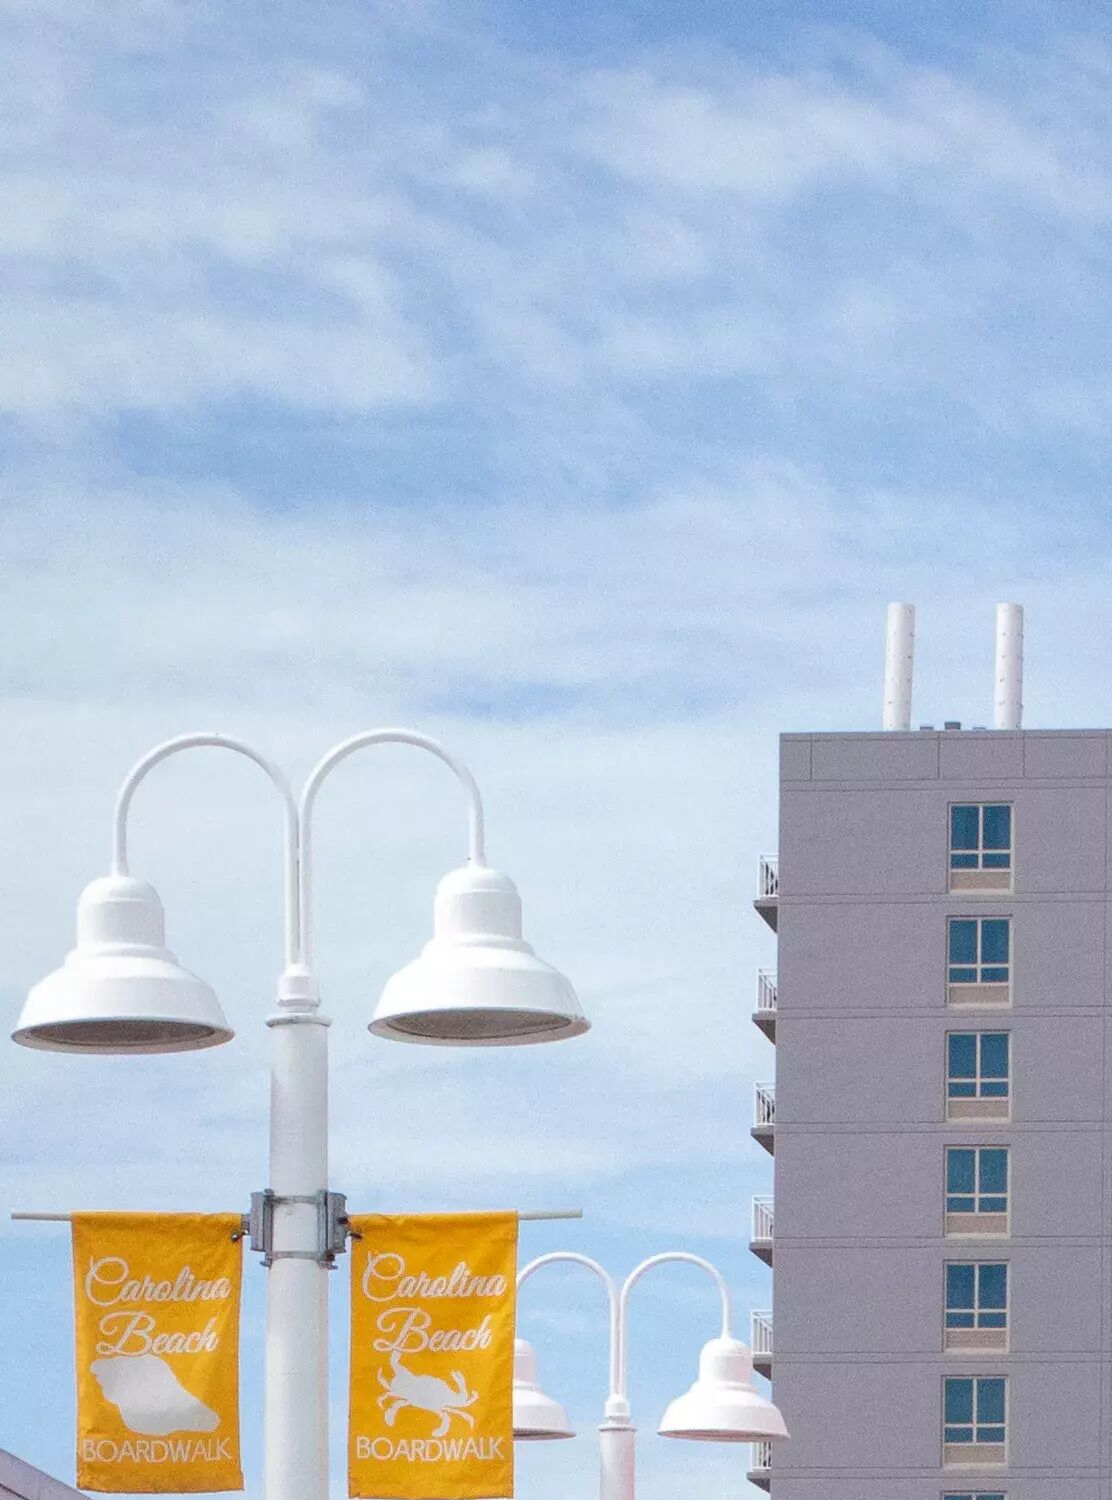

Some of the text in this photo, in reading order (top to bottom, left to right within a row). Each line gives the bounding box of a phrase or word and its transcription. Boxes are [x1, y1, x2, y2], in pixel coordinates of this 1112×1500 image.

[85, 1256, 231, 1307] Carolina
[362, 1251, 507, 1302] Carolina
[96, 1310, 221, 1356] Beach
[373, 1307, 493, 1353] Beach
[83, 1438, 232, 1463] BOARDWALK
[356, 1437, 505, 1461] BOARDWALK
